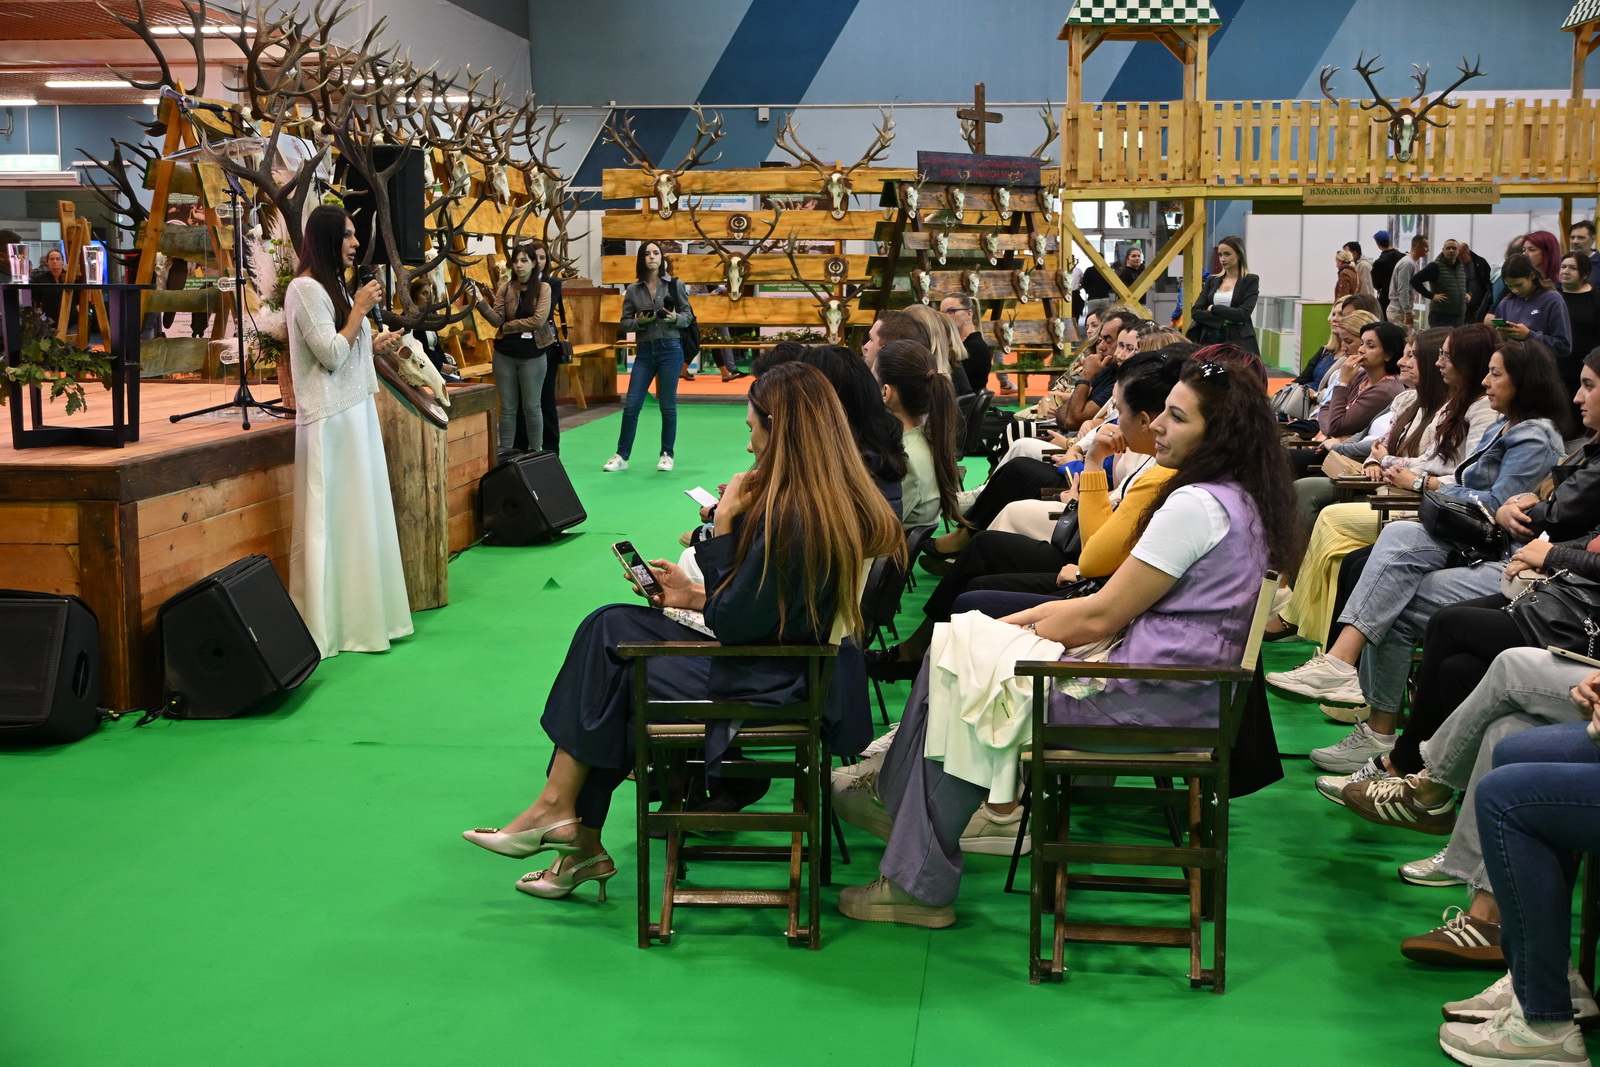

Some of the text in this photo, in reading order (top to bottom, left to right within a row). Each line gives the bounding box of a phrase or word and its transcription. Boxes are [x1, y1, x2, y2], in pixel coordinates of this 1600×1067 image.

[1310, 185, 1493, 196] ИЗЛОЖБЕНА ПОСТАВКА ЛОВАЧКИХ ТРОФЕЈА
[1386, 195, 1413, 203] СРБИЈЕ
